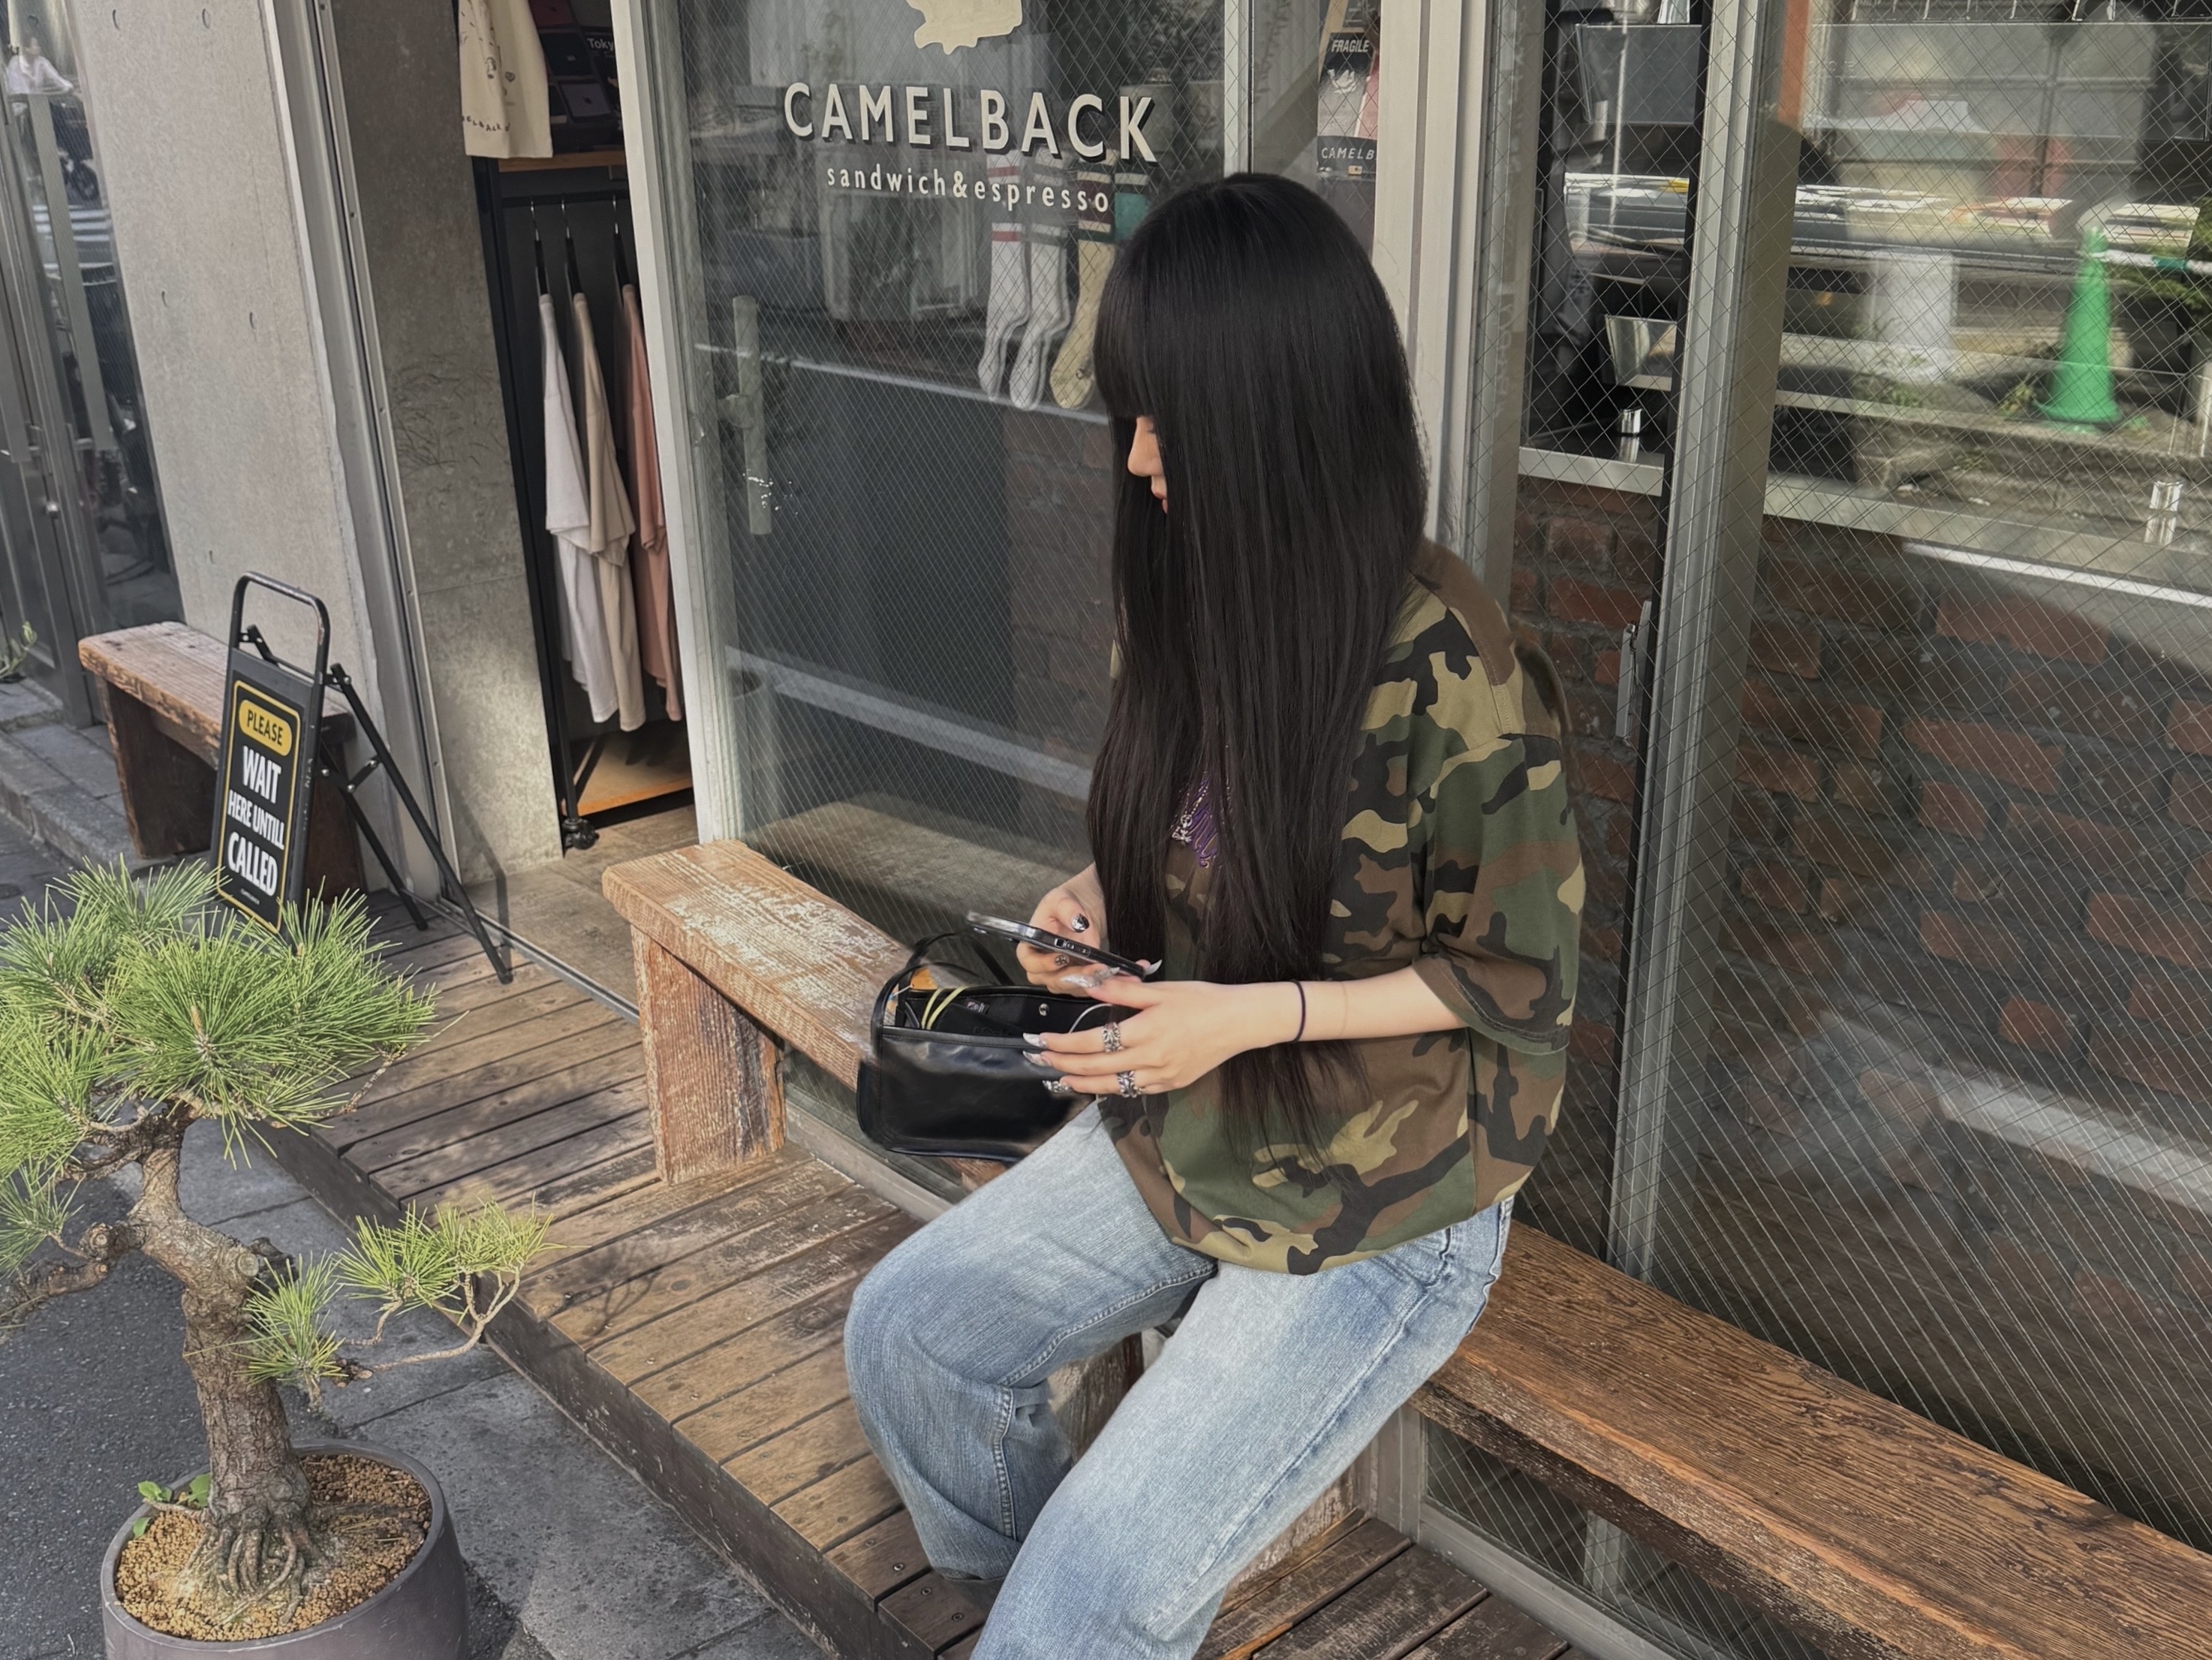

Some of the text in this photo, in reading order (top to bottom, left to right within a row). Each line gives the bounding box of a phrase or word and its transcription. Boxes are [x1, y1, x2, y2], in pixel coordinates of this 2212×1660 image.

[1332, 39, 1369, 53] FRAGILE
[784, 82, 1157, 163] CAMELBACK
[1321, 147, 1377, 160] CAMELB
[826, 164, 1109, 211] sandwich&espresso
[248, 709, 283, 746] PLEASE
[242, 745, 282, 804] WAIT
[227, 790, 284, 850] HERE UNTILL
[227, 831, 278, 896] CALLED
